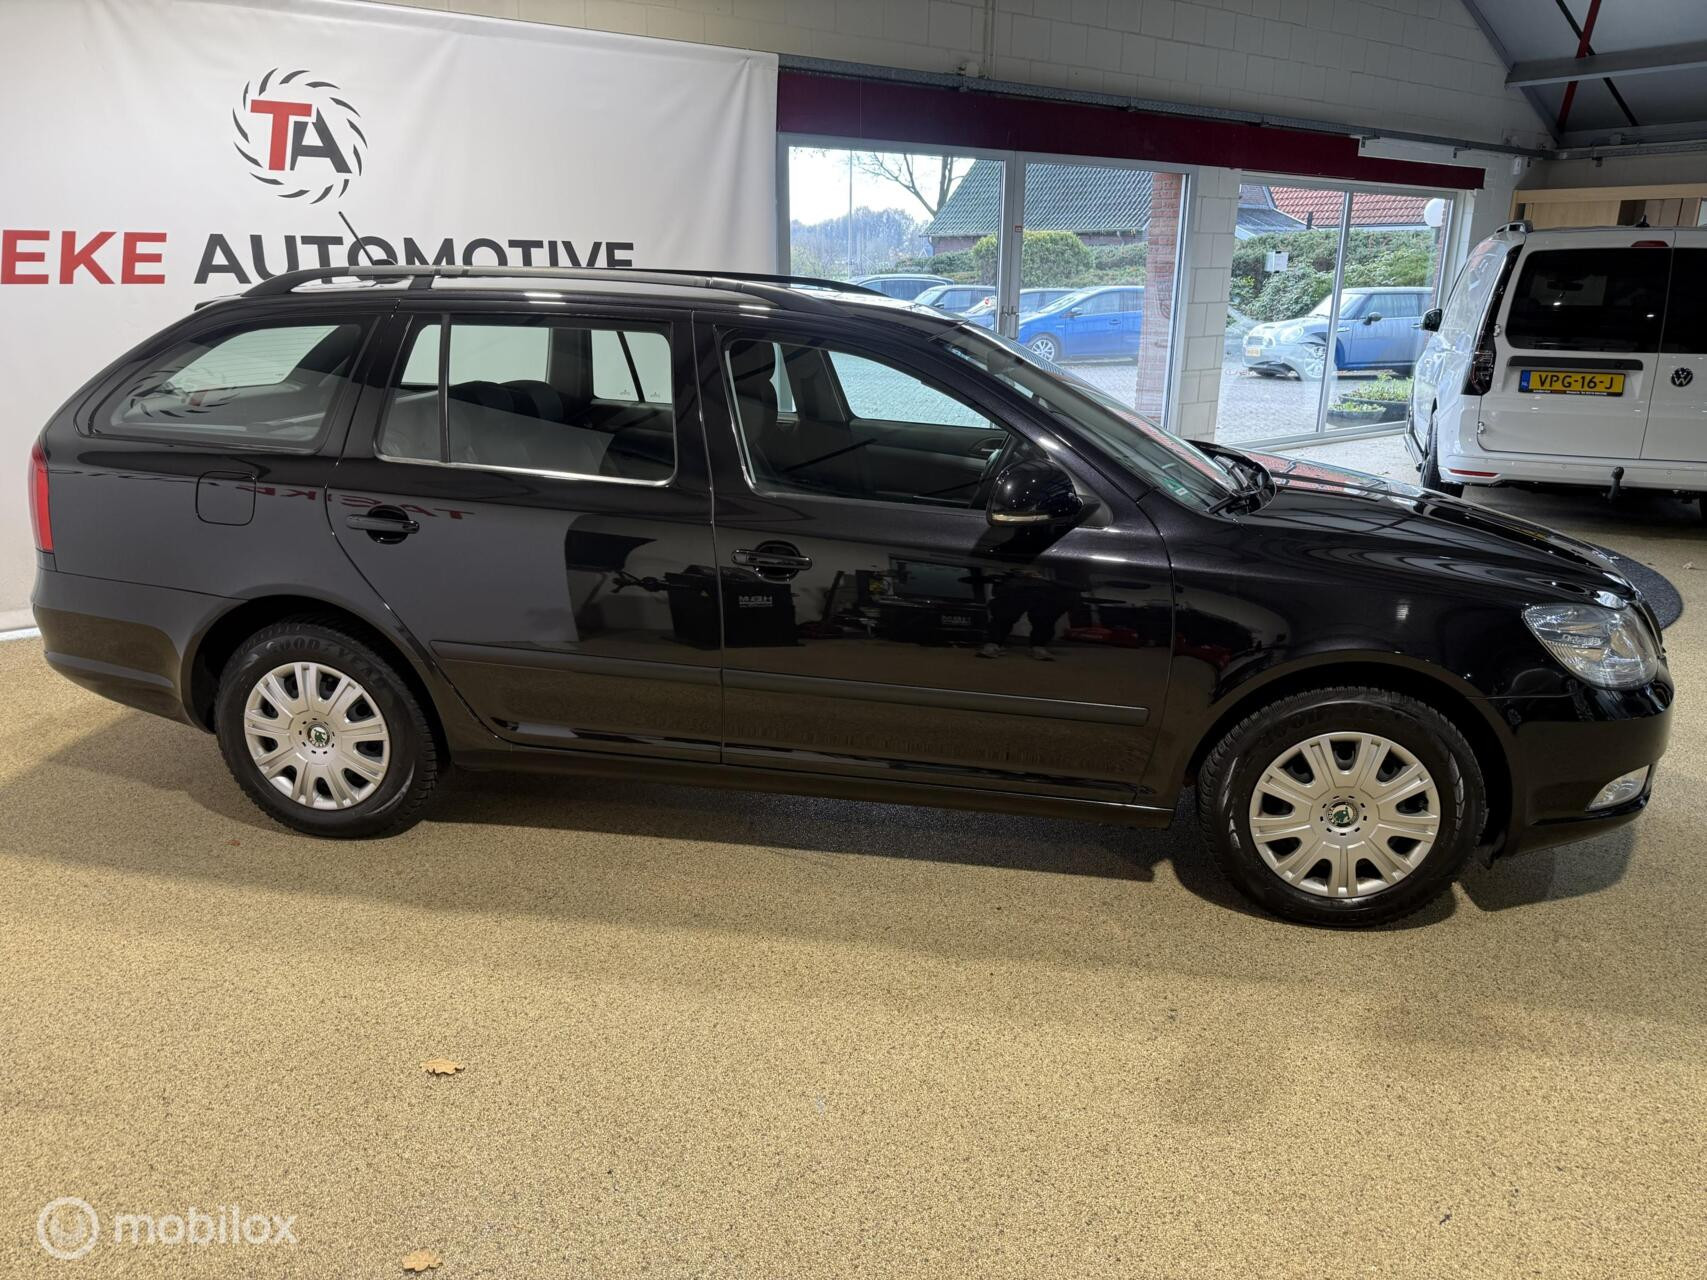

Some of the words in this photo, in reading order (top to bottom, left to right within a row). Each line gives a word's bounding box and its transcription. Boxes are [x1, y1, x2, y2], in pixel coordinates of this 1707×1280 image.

[250, 99, 353, 174] TA
[1, 229, 167, 285] EKE
[193, 232, 635, 285] AUTOMOTIVE
[1538, 373, 1615, 391] VPG-16-J
